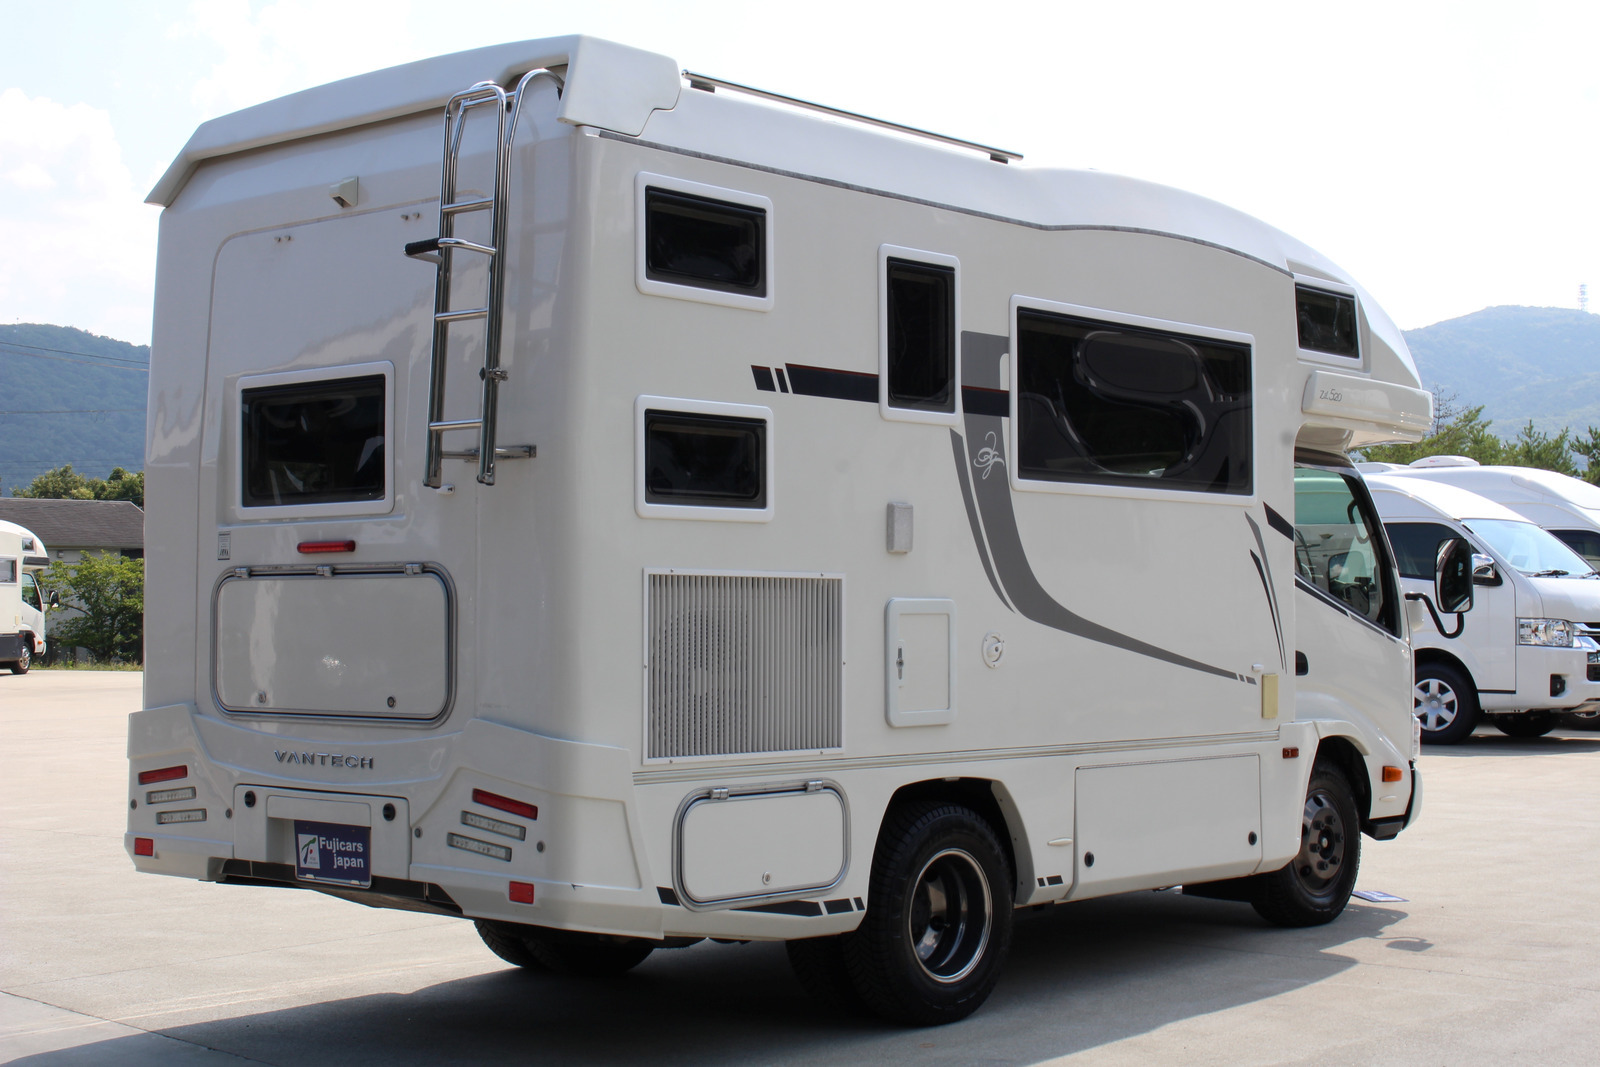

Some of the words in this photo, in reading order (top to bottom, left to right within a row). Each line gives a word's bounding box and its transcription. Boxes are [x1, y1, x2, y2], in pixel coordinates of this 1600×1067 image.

[274, 750, 373, 769] VANTECH
[319, 836, 364, 853] Fujicars
[333, 853, 364, 869] japan
